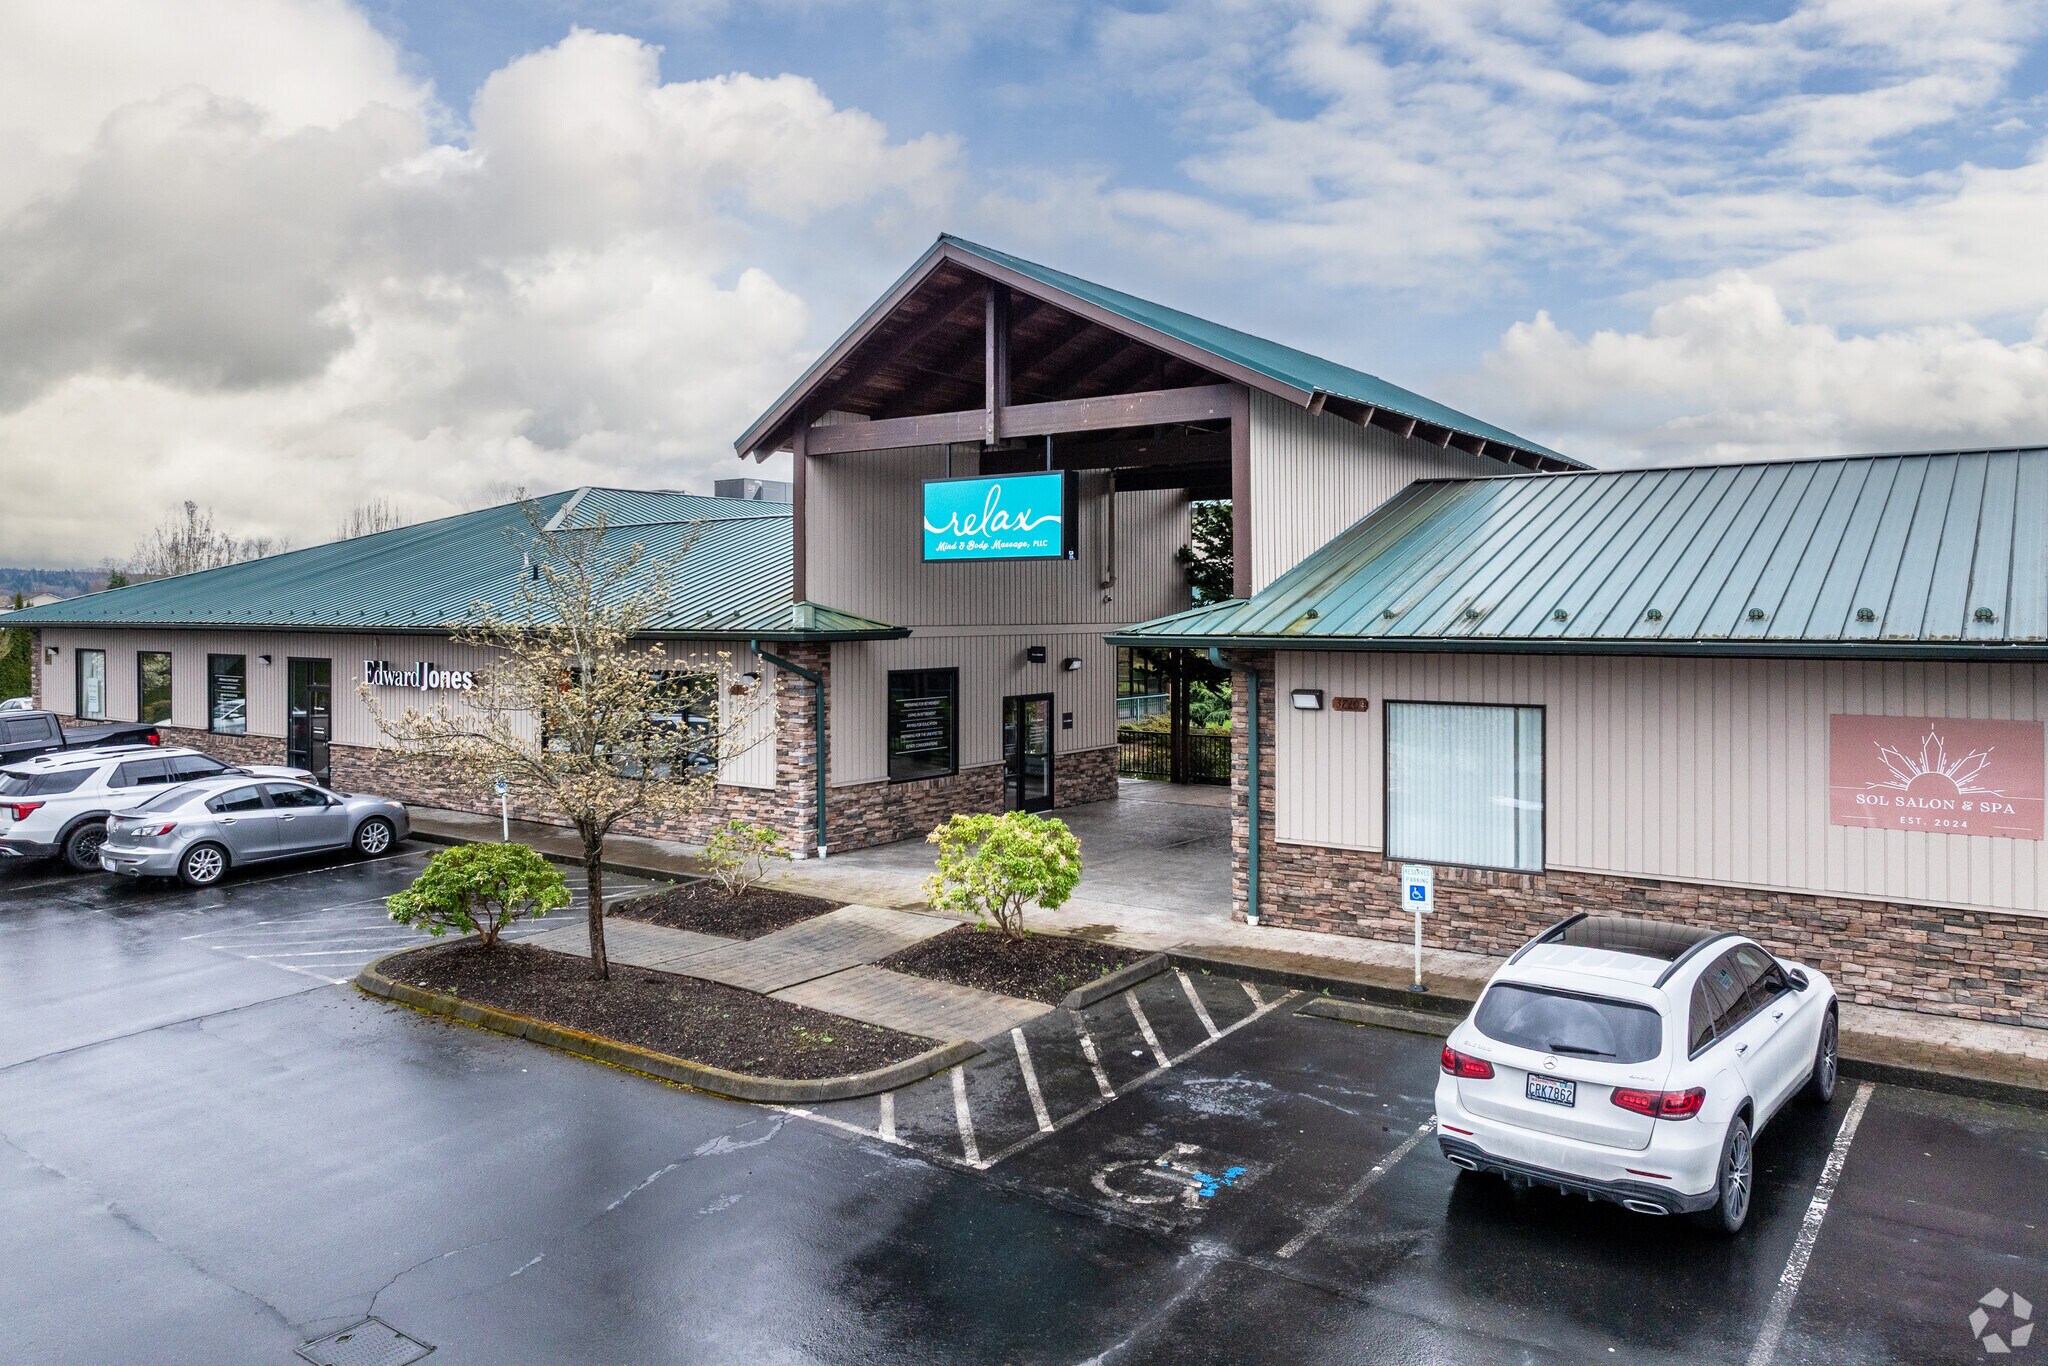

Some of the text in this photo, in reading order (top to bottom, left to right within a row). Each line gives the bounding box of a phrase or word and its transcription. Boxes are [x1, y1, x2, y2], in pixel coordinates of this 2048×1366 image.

[925, 484, 1061, 537] relax
[936, 541, 956, 552] Mind
[959, 541, 965, 550] &
[967, 540, 988, 550] Body
[363, 660, 473, 691] Edward Jones
[1856, 794, 2016, 815] SOL SALON & SPA
[1900, 816, 1968, 828] EST. 2024
[1528, 1082, 1573, 1103] CRK7862
